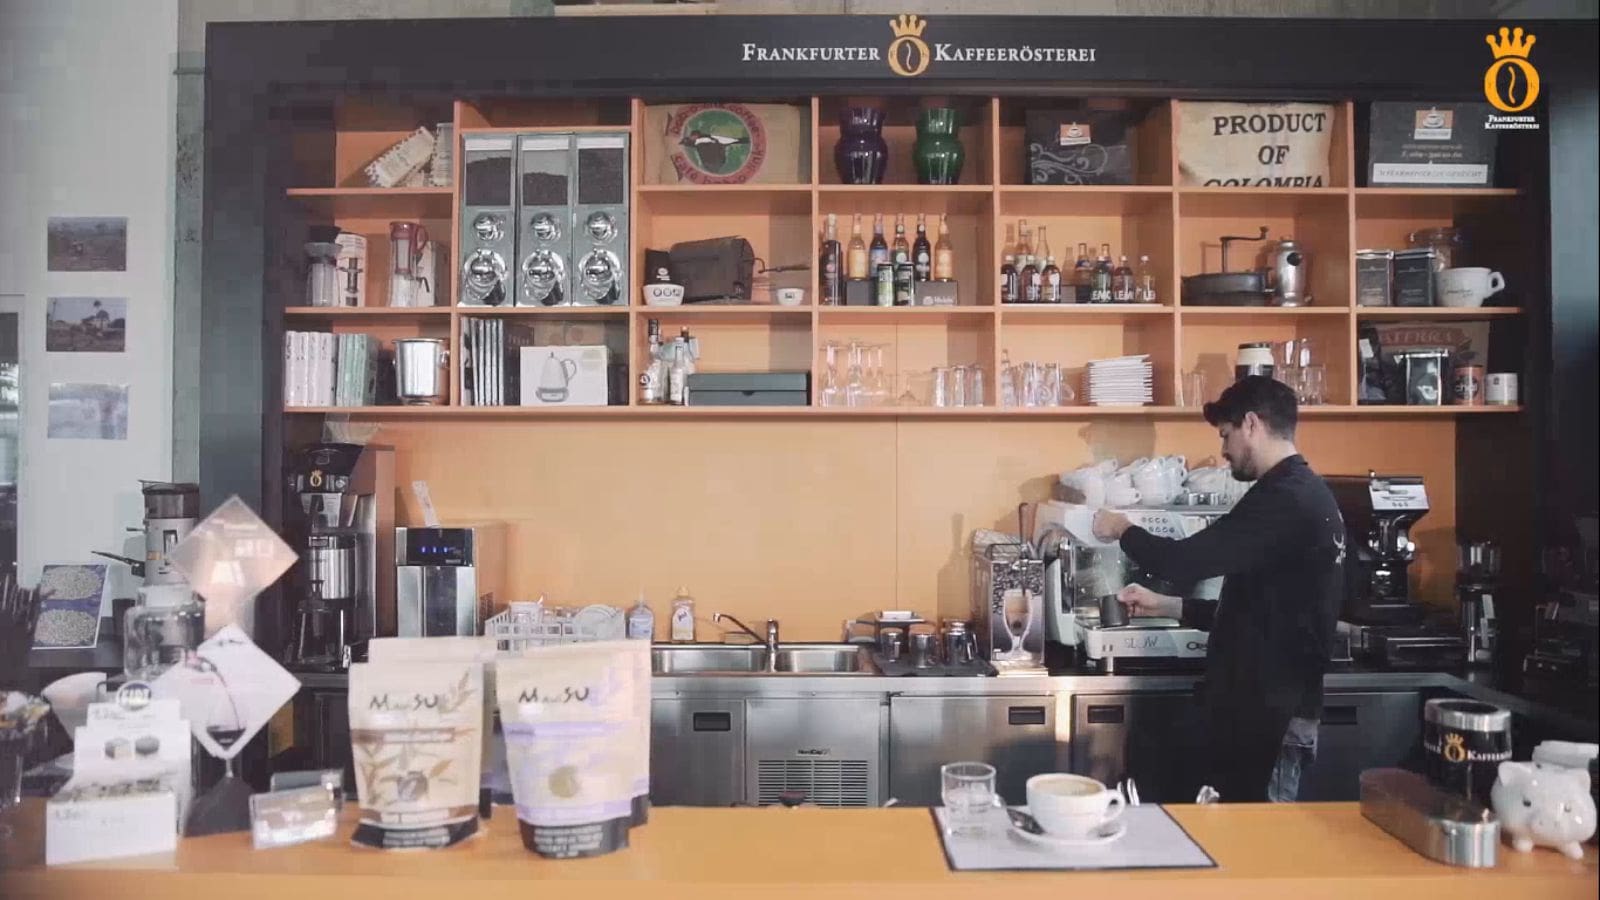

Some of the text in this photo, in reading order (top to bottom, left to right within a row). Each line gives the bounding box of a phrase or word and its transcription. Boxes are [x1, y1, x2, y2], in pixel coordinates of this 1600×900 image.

[742, 43, 1097, 63] FRANKFURTER KAFFEERÖSTEREI
[1213, 113, 1326, 136] PRODUCT
[1258, 145, 1290, 165] OF
